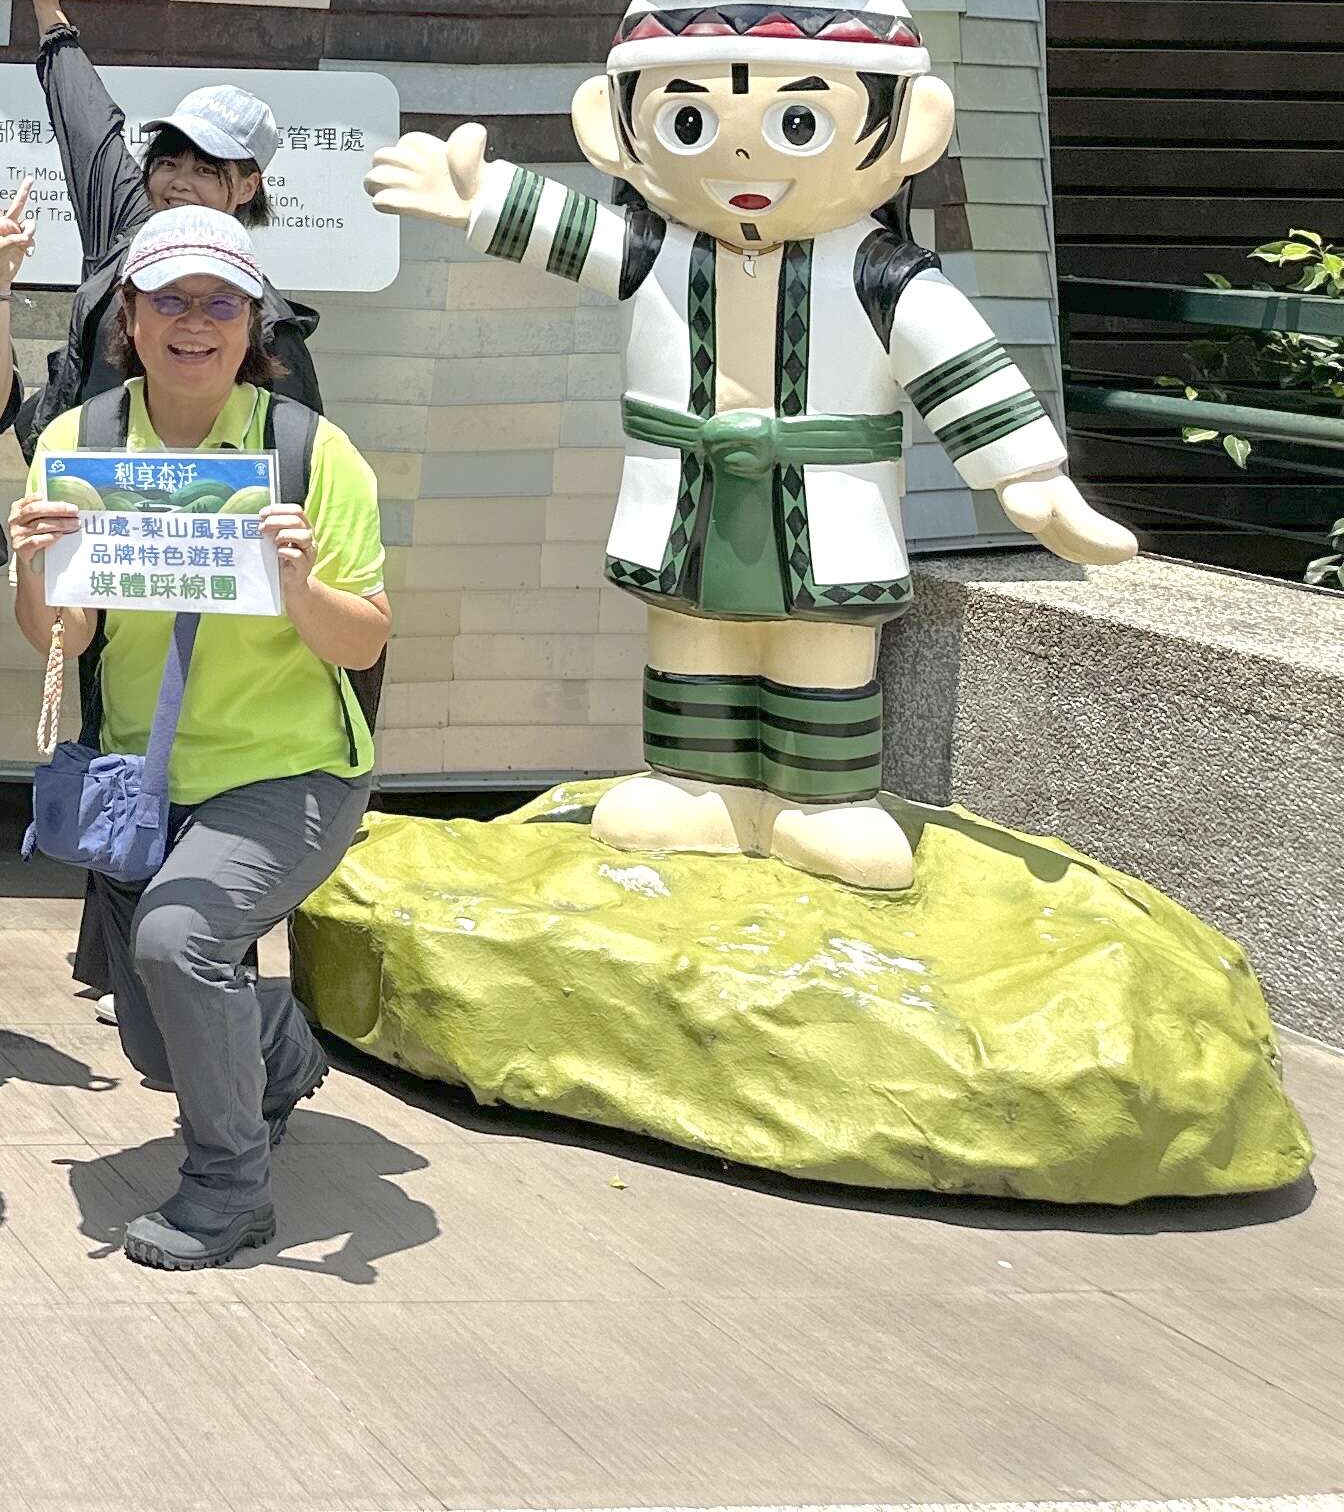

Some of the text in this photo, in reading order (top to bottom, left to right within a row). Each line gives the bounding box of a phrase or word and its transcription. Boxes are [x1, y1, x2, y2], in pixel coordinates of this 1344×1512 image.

[7, 166, 66, 181] Tri-Mou
[25, 207, 42, 220] of
[271, 215, 344, 229] nications
[90, 543, 235, 568] 品牌特色遊程
[89, 570, 237, 601] 媒體踩線團
